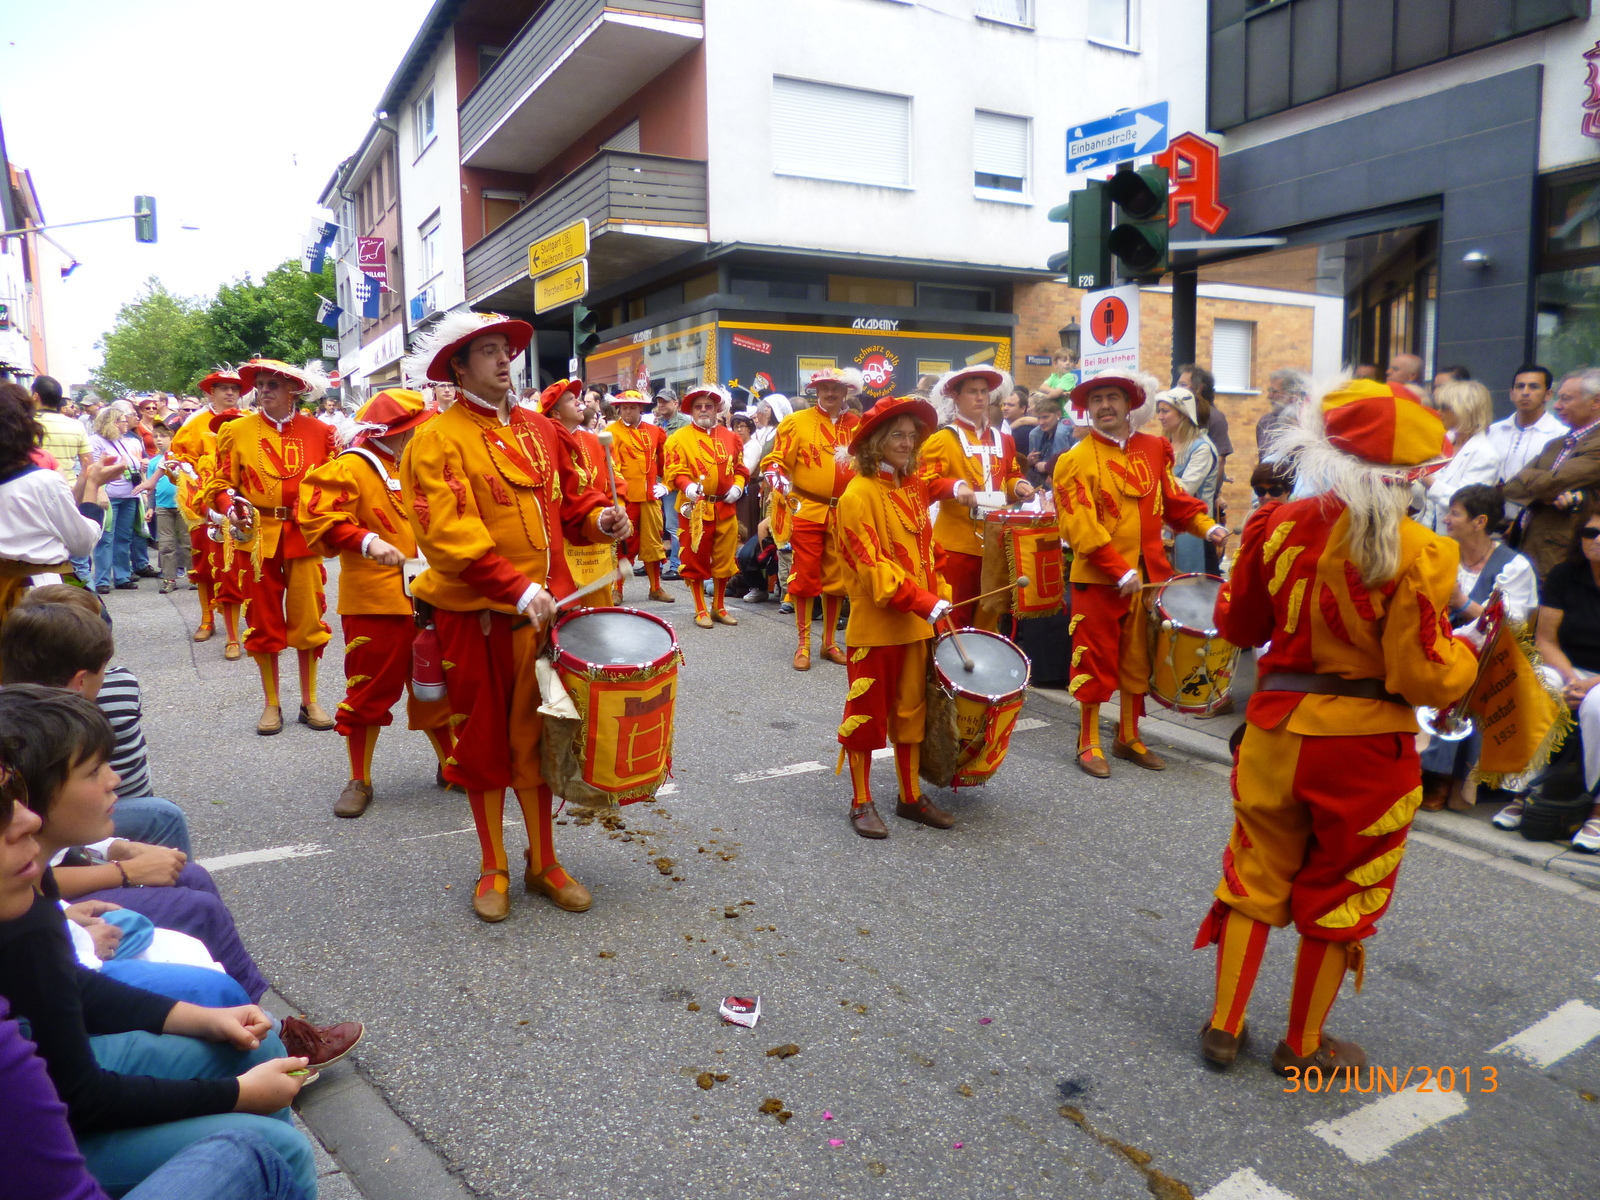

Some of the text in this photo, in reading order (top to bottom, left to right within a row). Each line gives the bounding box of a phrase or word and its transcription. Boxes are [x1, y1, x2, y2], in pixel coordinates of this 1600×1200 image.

[1071, 129, 1137, 155] Einbahnstraße
[540, 237, 562, 255] Stuttgart
[541, 251, 564, 268] Heilbronn
[1078, 275, 1094, 287] F26
[543, 283, 565, 299] Pforzheim
[852, 317, 899, 331] ACADEMY
[326, 344, 336, 352] MK
[762, 342, 770, 350] 17
[853, 345, 900, 367] Schwarz gelb
[1084, 359, 1096, 367] Bei
[1097, 356, 1109, 365] Rot
[575, 558, 600, 567] Rastatt
[1493, 723, 1517, 746] 1952
